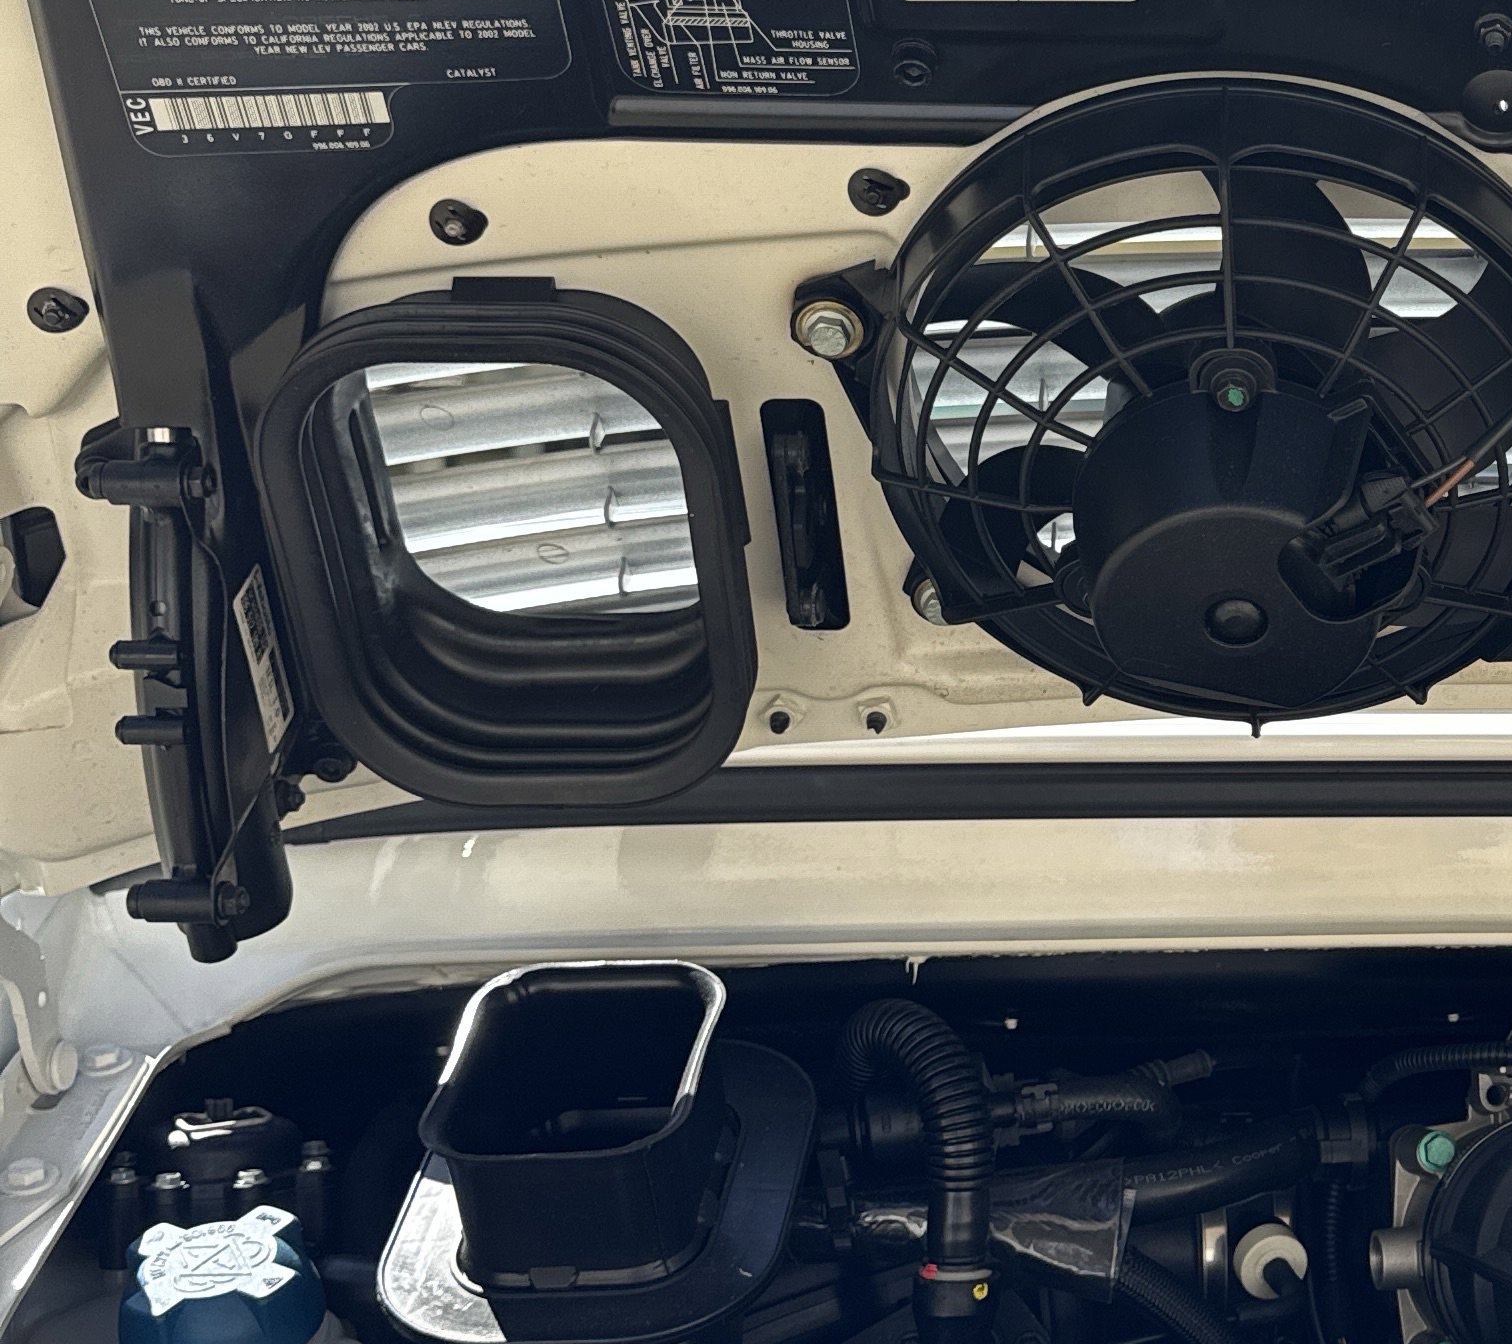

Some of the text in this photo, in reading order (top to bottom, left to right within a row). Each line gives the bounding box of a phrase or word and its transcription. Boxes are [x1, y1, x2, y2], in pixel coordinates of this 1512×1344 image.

[165, 26, 206, 36] VEHICLE
[211, 25, 264, 35] CONFORMS
[269, 24, 283, 34] TO
[287, 24, 320, 33] MODEL
[406, 21, 427, 31] EPA
[154, 37, 180, 47] ALSO
[185, 36, 238, 46] CONFORMS
[243, 35, 257, 45] TO
[261, 34, 319, 44] CALIFORNIA
[323, 33, 390, 43] REGULATIONS
[395, 31, 454, 41] APPLICABLE
[459, 30, 473, 40] TO
[503, 29, 536, 38] MODEL
[770, 29, 847, 40] THROTTLE VALVE
[336, 43, 394, 53] PASSENGER
[742, 56, 767, 65] MASS
[788, 56, 813, 65] FLOW
[446, 68, 496, 79] CATALYST
[780, 72, 808, 81] VALVE
[186, 76, 237, 86] CERTIFIED
[126, 97, 154, 136] VEC
